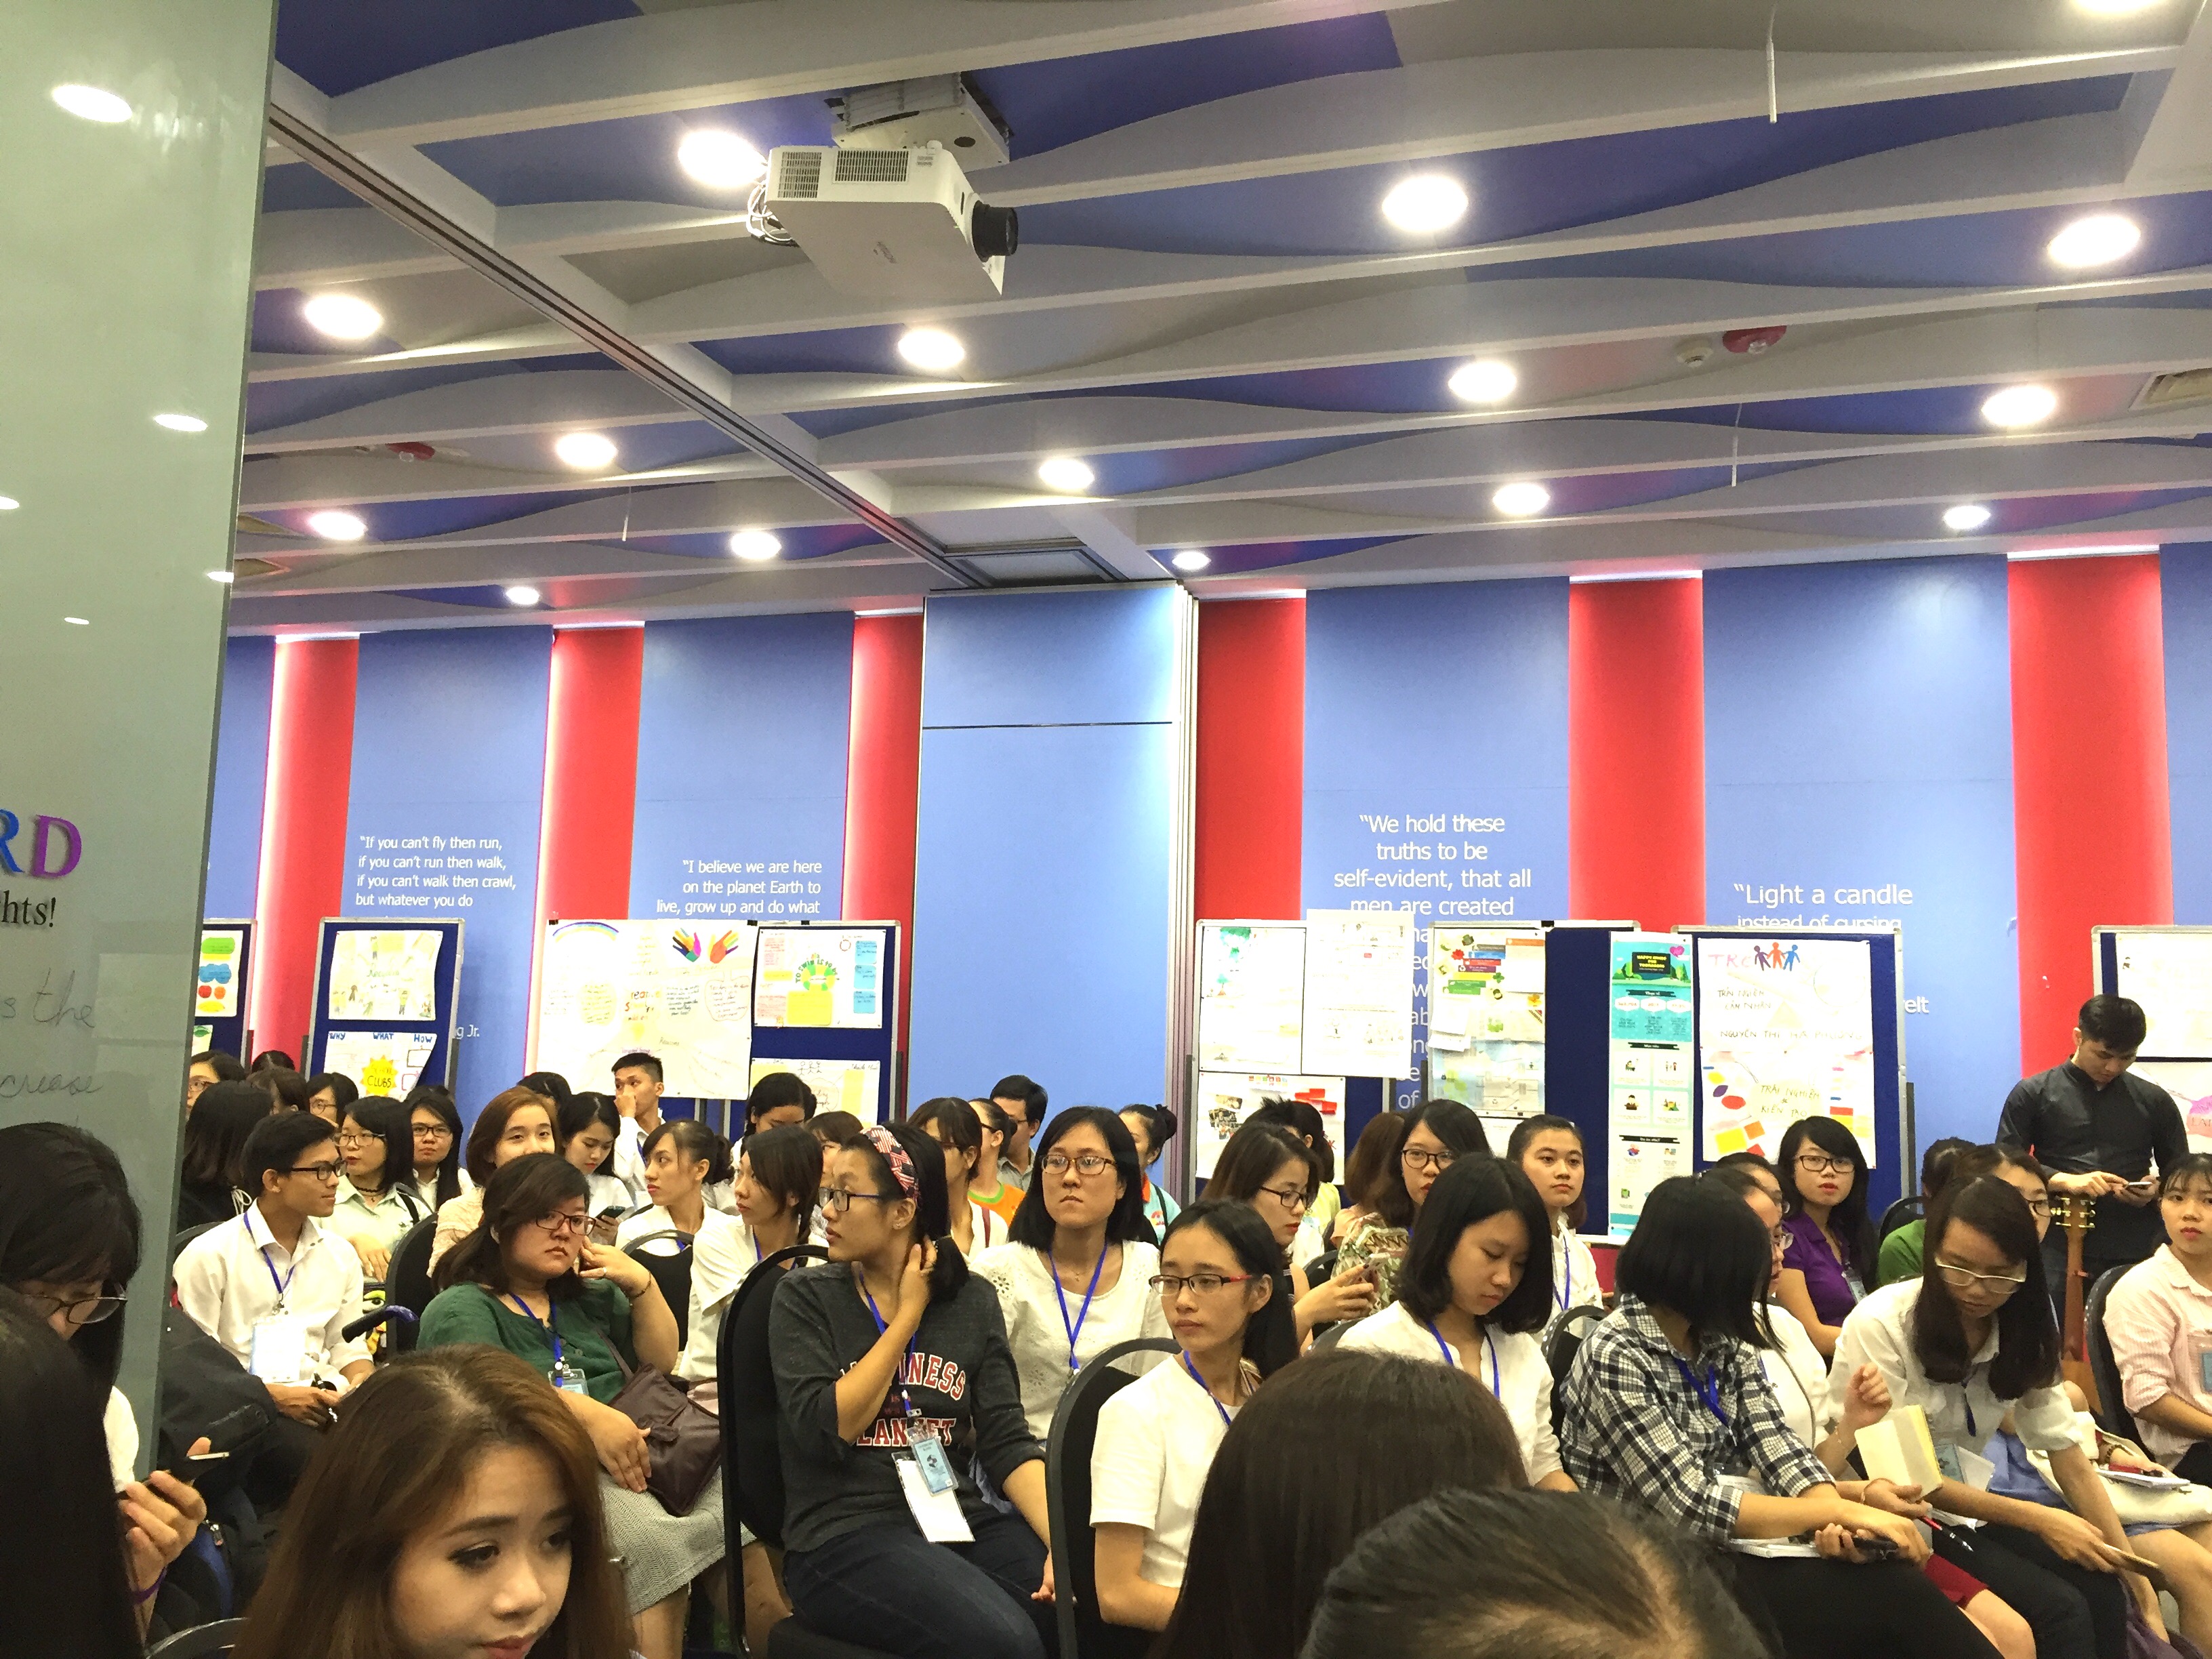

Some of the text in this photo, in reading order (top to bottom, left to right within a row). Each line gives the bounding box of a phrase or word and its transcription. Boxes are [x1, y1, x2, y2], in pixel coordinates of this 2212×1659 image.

[1406, 814, 1445, 832] hold
[1452, 814, 1504, 832] these
[378, 839, 398, 851] you
[402, 836, 429, 848] can't
[433, 836, 446, 851] fly
[451, 836, 475, 848] then
[480, 840, 502, 851] run,
[1376, 841, 1488, 859] truths to be
[359, 855, 506, 870] if you can't run then walk,
[699, 860, 741, 873] believe
[746, 863, 764, 873] we
[769, 863, 789, 873] are
[794, 860, 822, 873] here
[357, 874, 516, 890] if you can't walk then crawl,
[683, 880, 821, 896] on the planet Earth to
[1334, 869, 1530, 890] self-evident, that all
[356, 893, 472, 909] but whatever you do
[1812, 889, 1824, 904] a
[1835, 884, 1912, 904] candle
[0, 890, 56, 927] hts!
[657, 899, 820, 916] live, grow up and do what
[1351, 897, 1514, 916] men are created
[1738, 914, 1803, 926] instead
[33, 967, 95, 1028] the
[467, 1025, 479, 1037] Jr.
[1399, 1091, 1419, 1109] of
